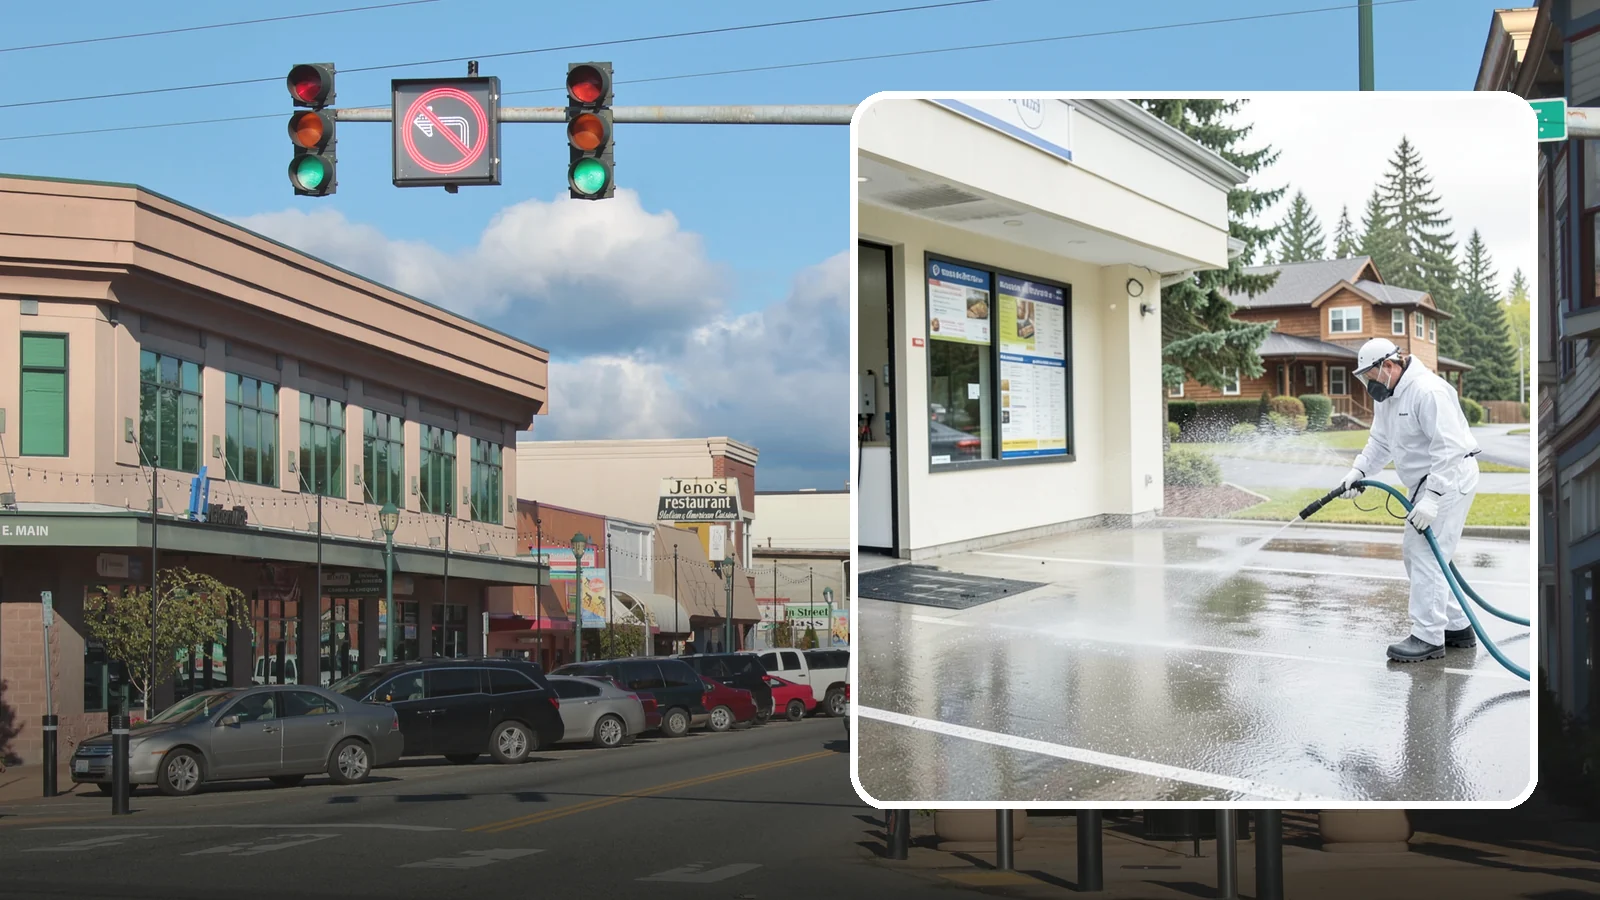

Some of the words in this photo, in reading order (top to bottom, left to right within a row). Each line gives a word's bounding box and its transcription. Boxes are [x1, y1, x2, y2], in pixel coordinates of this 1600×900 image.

[670, 480, 728, 494] Jeno's
[665, 496, 731, 509] restaurant
[658, 510, 682, 520] Italian
[685, 510, 714, 519] American
[715, 509, 737, 519] Cuisine
[2, 525, 13, 536] E.
[15, 525, 49, 536] MAIN
[797, 607, 829, 617] Street
[791, 619, 824, 627] lass
